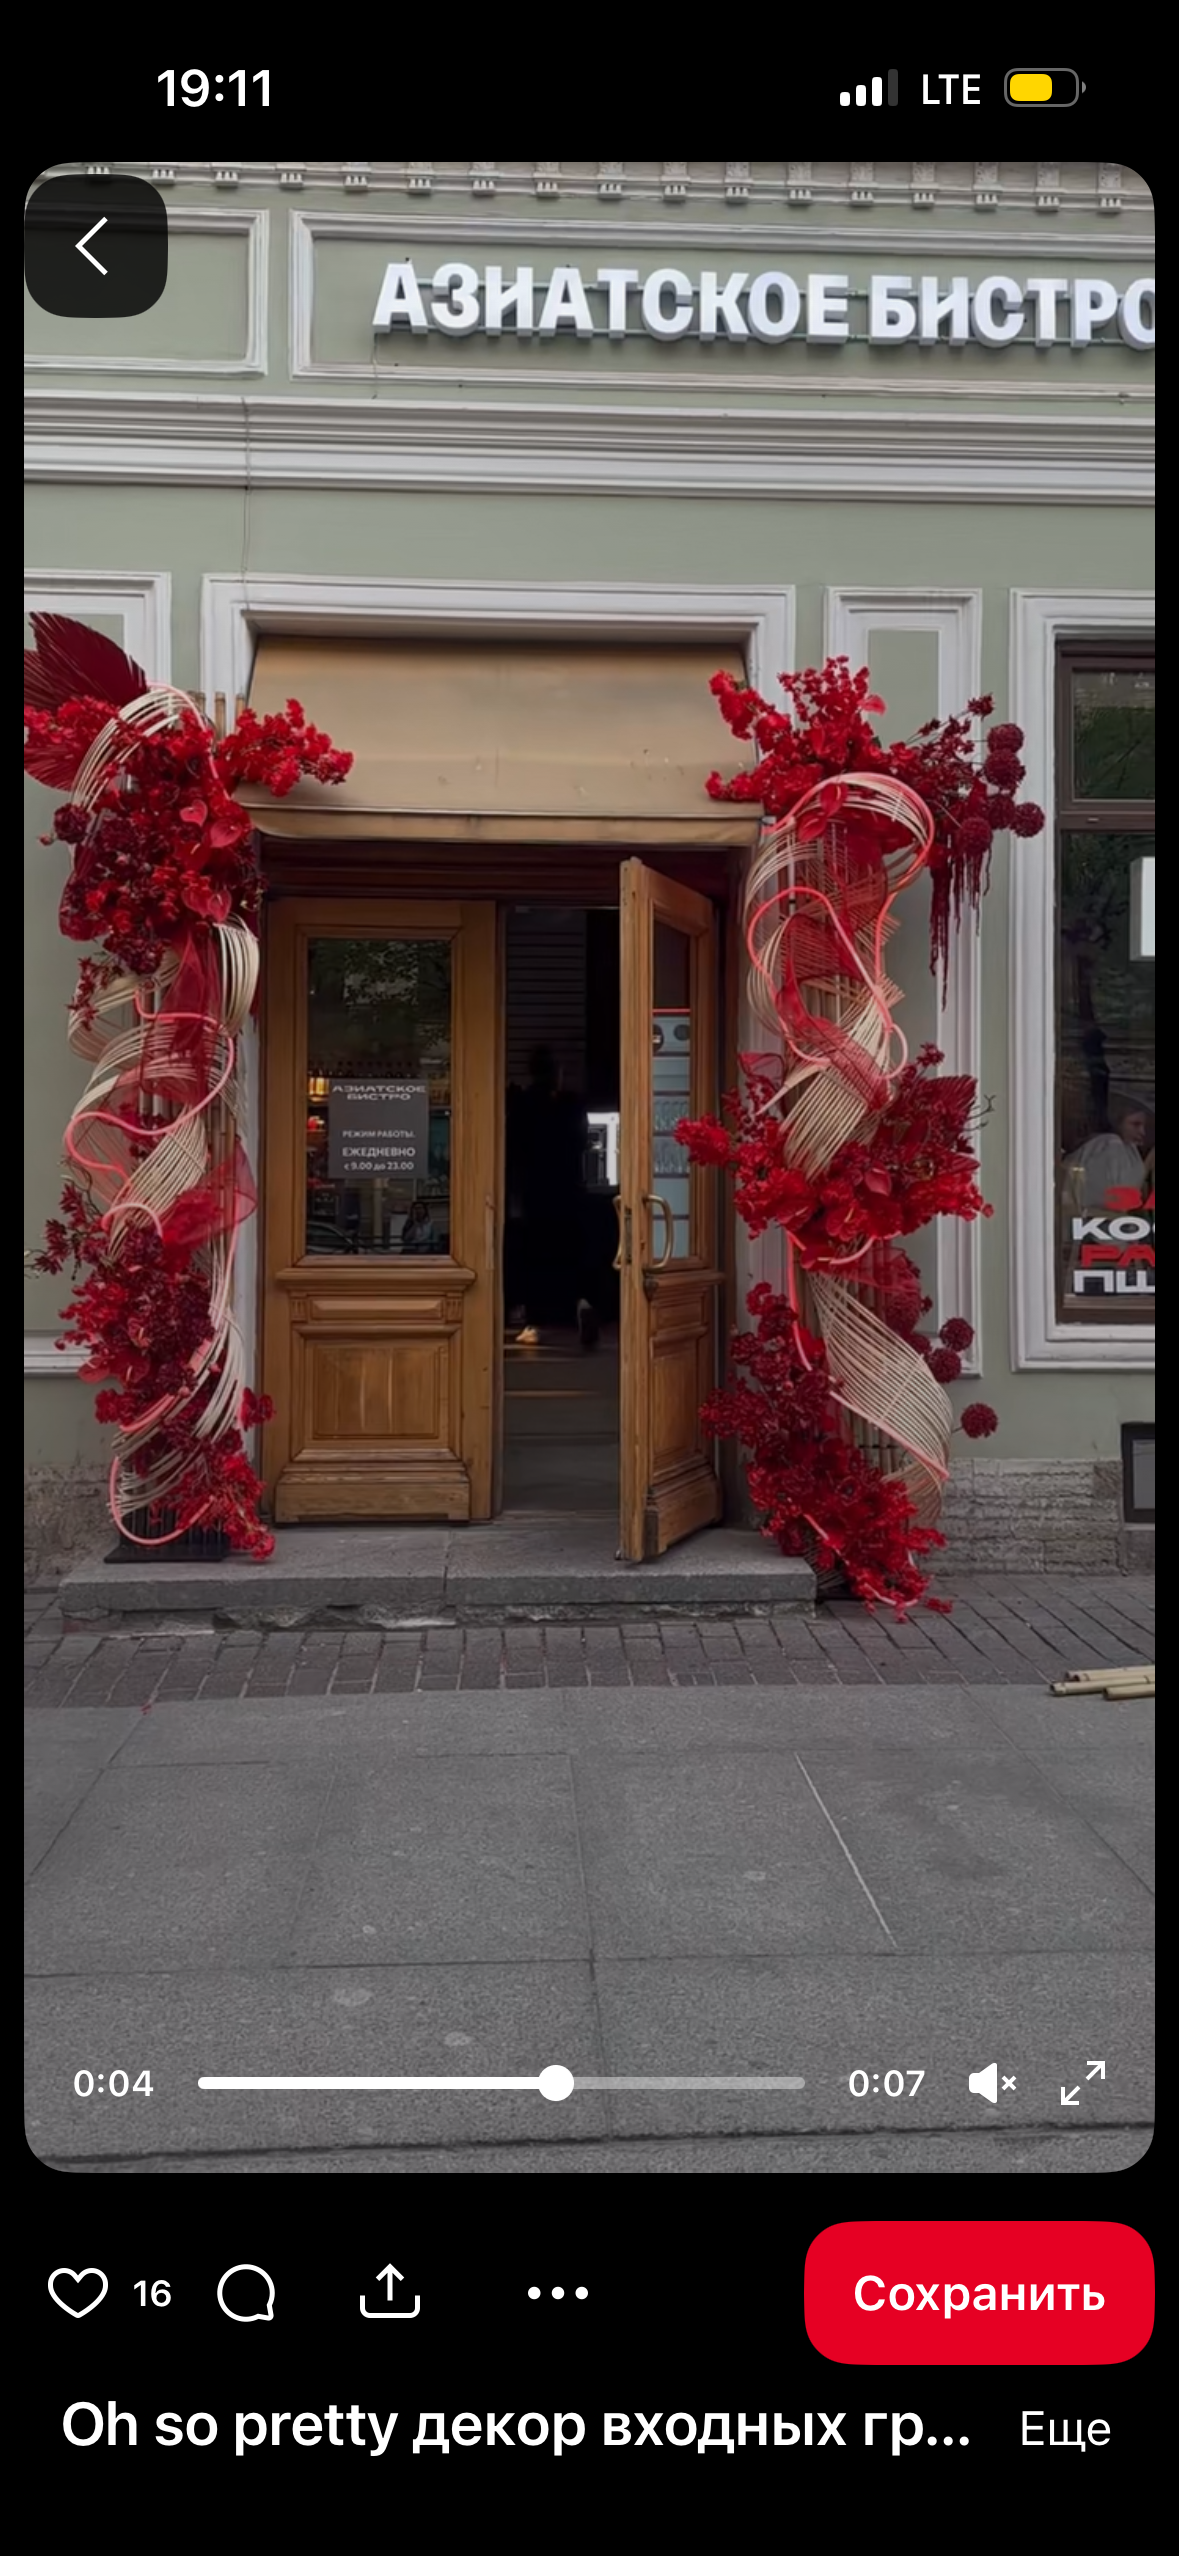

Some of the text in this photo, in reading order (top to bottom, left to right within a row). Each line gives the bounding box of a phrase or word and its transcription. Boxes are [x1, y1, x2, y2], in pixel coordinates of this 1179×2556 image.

[372, 262, 1155, 350] АЗИАТСКОЕ БИСТРО
[332, 1085, 426, 1093] АЗИАТСКОЕ
[346, 1093, 411, 1101] БИСТРО
[342, 1130, 375, 1138] РЕЖИМ
[342, 1147, 416, 1158] ЕЖЕДНЕВНО
[351, 1161, 372, 1170] 9.00
[373, 1163, 386, 1171] до
[387, 1161, 414, 1170] 23.00
[1072, 1216, 1155, 1240] КО
